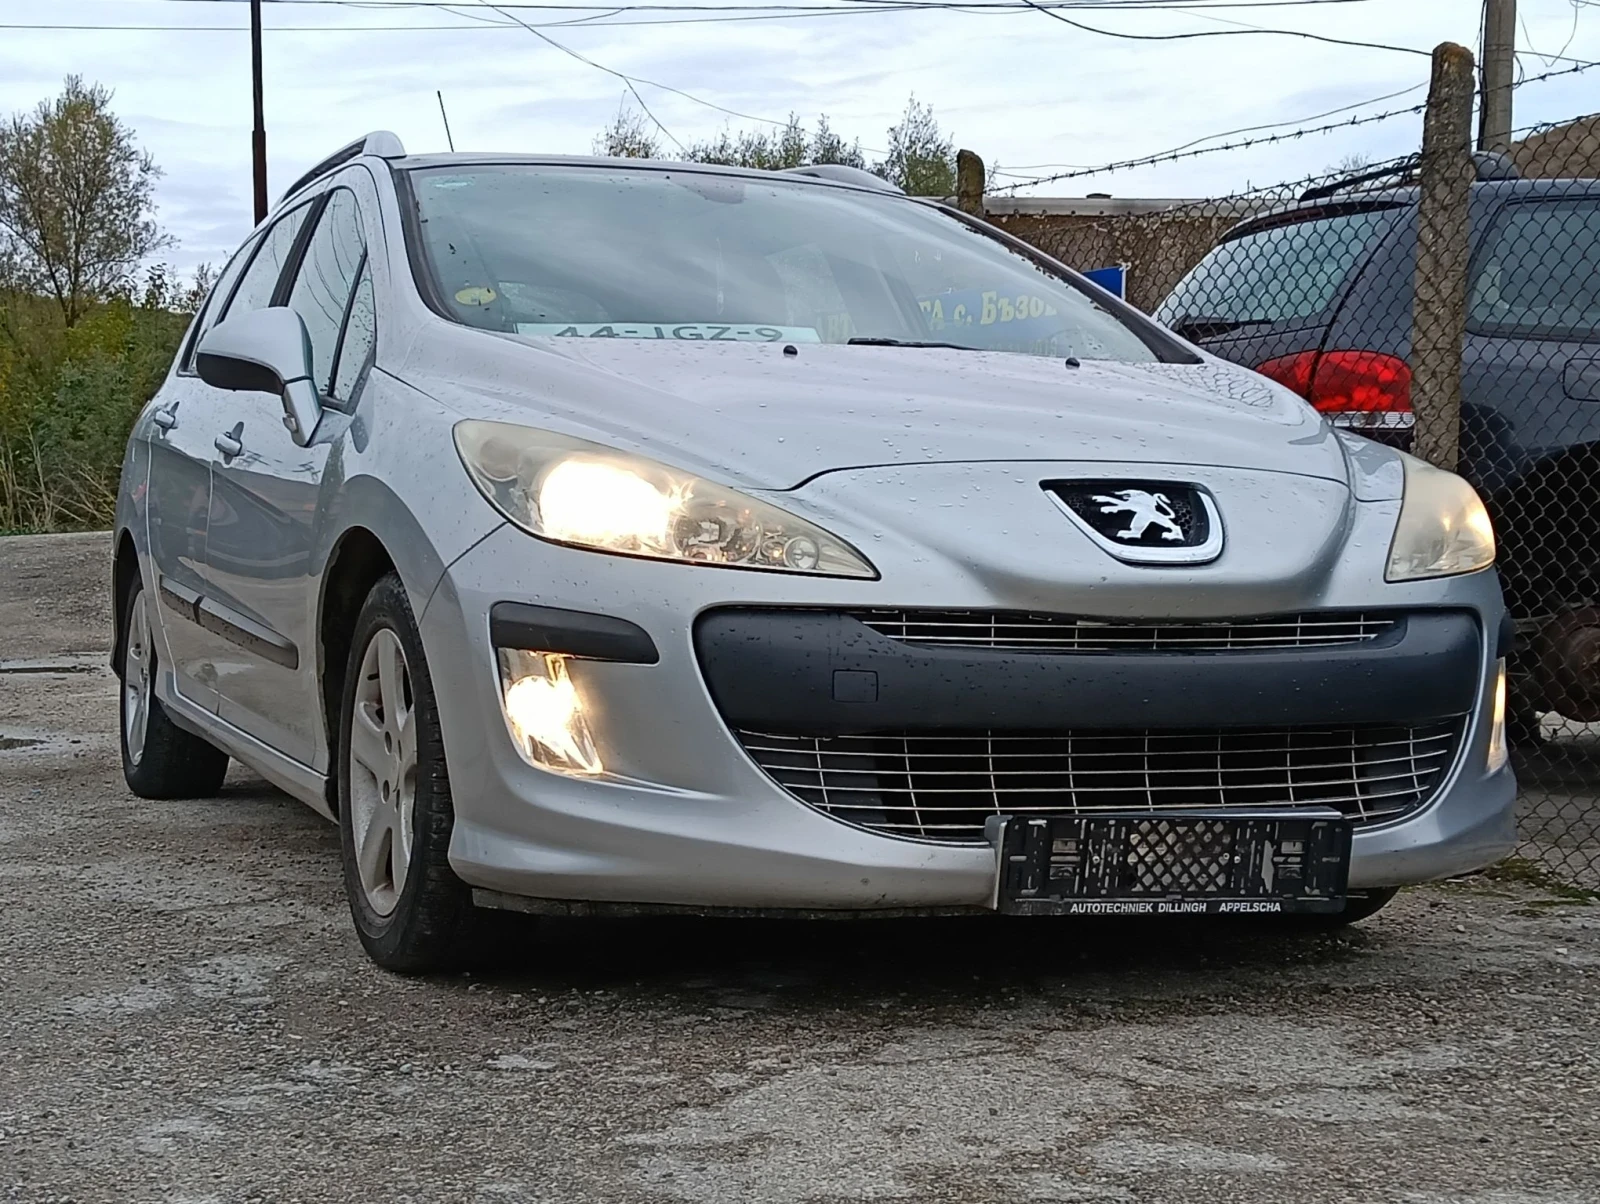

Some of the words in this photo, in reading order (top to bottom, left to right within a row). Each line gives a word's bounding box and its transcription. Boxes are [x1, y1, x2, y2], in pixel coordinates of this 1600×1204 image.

[1070, 902, 1154, 914] AUTOTECHNIEK
[1158, 902, 1207, 913] DILLINGH
[1219, 902, 1282, 912] APPELSCHA
